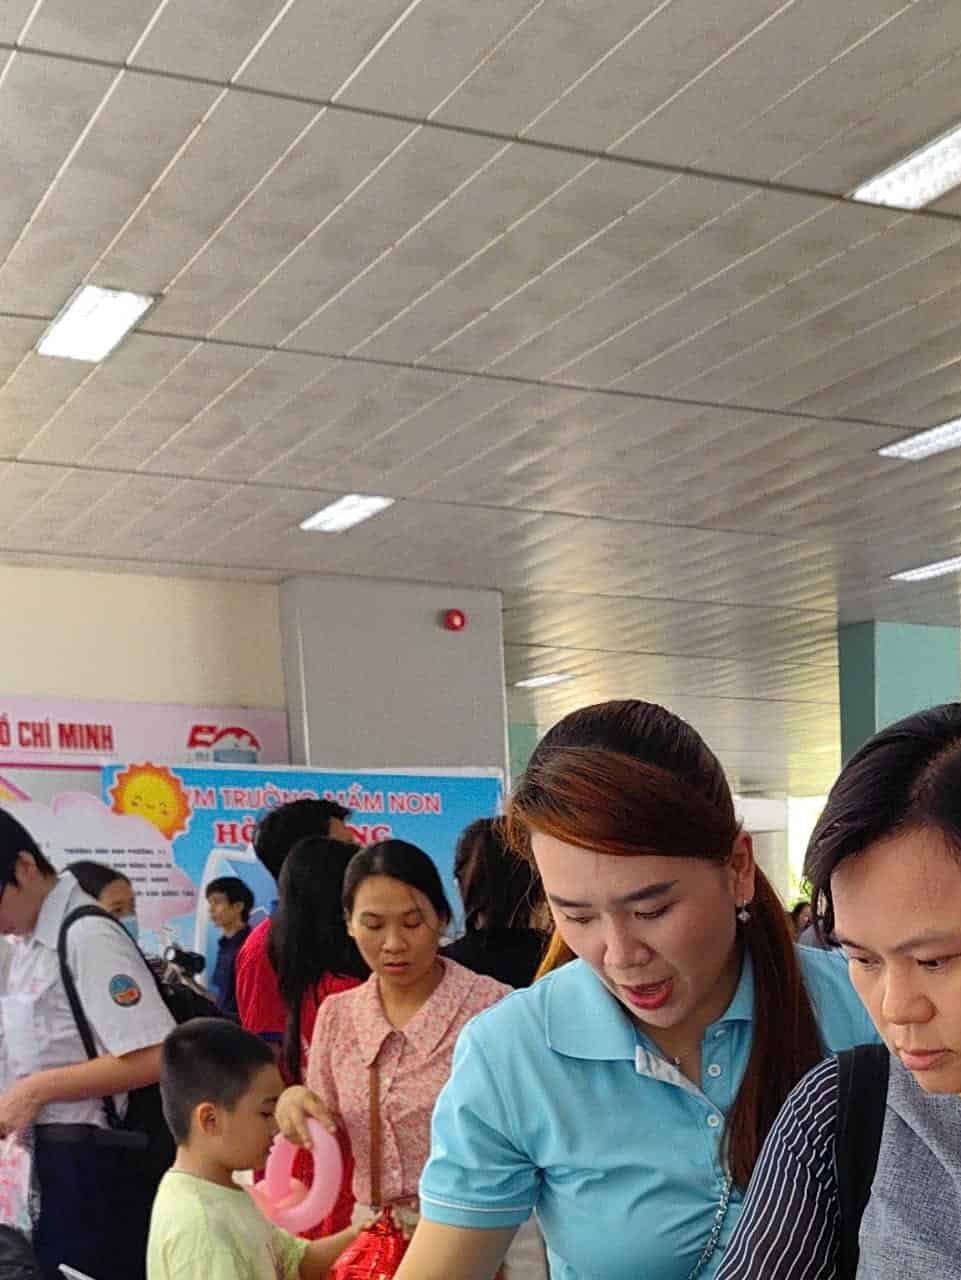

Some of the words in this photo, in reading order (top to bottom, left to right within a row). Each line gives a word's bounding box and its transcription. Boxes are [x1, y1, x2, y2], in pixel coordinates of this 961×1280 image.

[18, 716, 51, 748] CHÍ
[58, 722, 114, 751] MINH
[388, 790, 441, 813] NON
